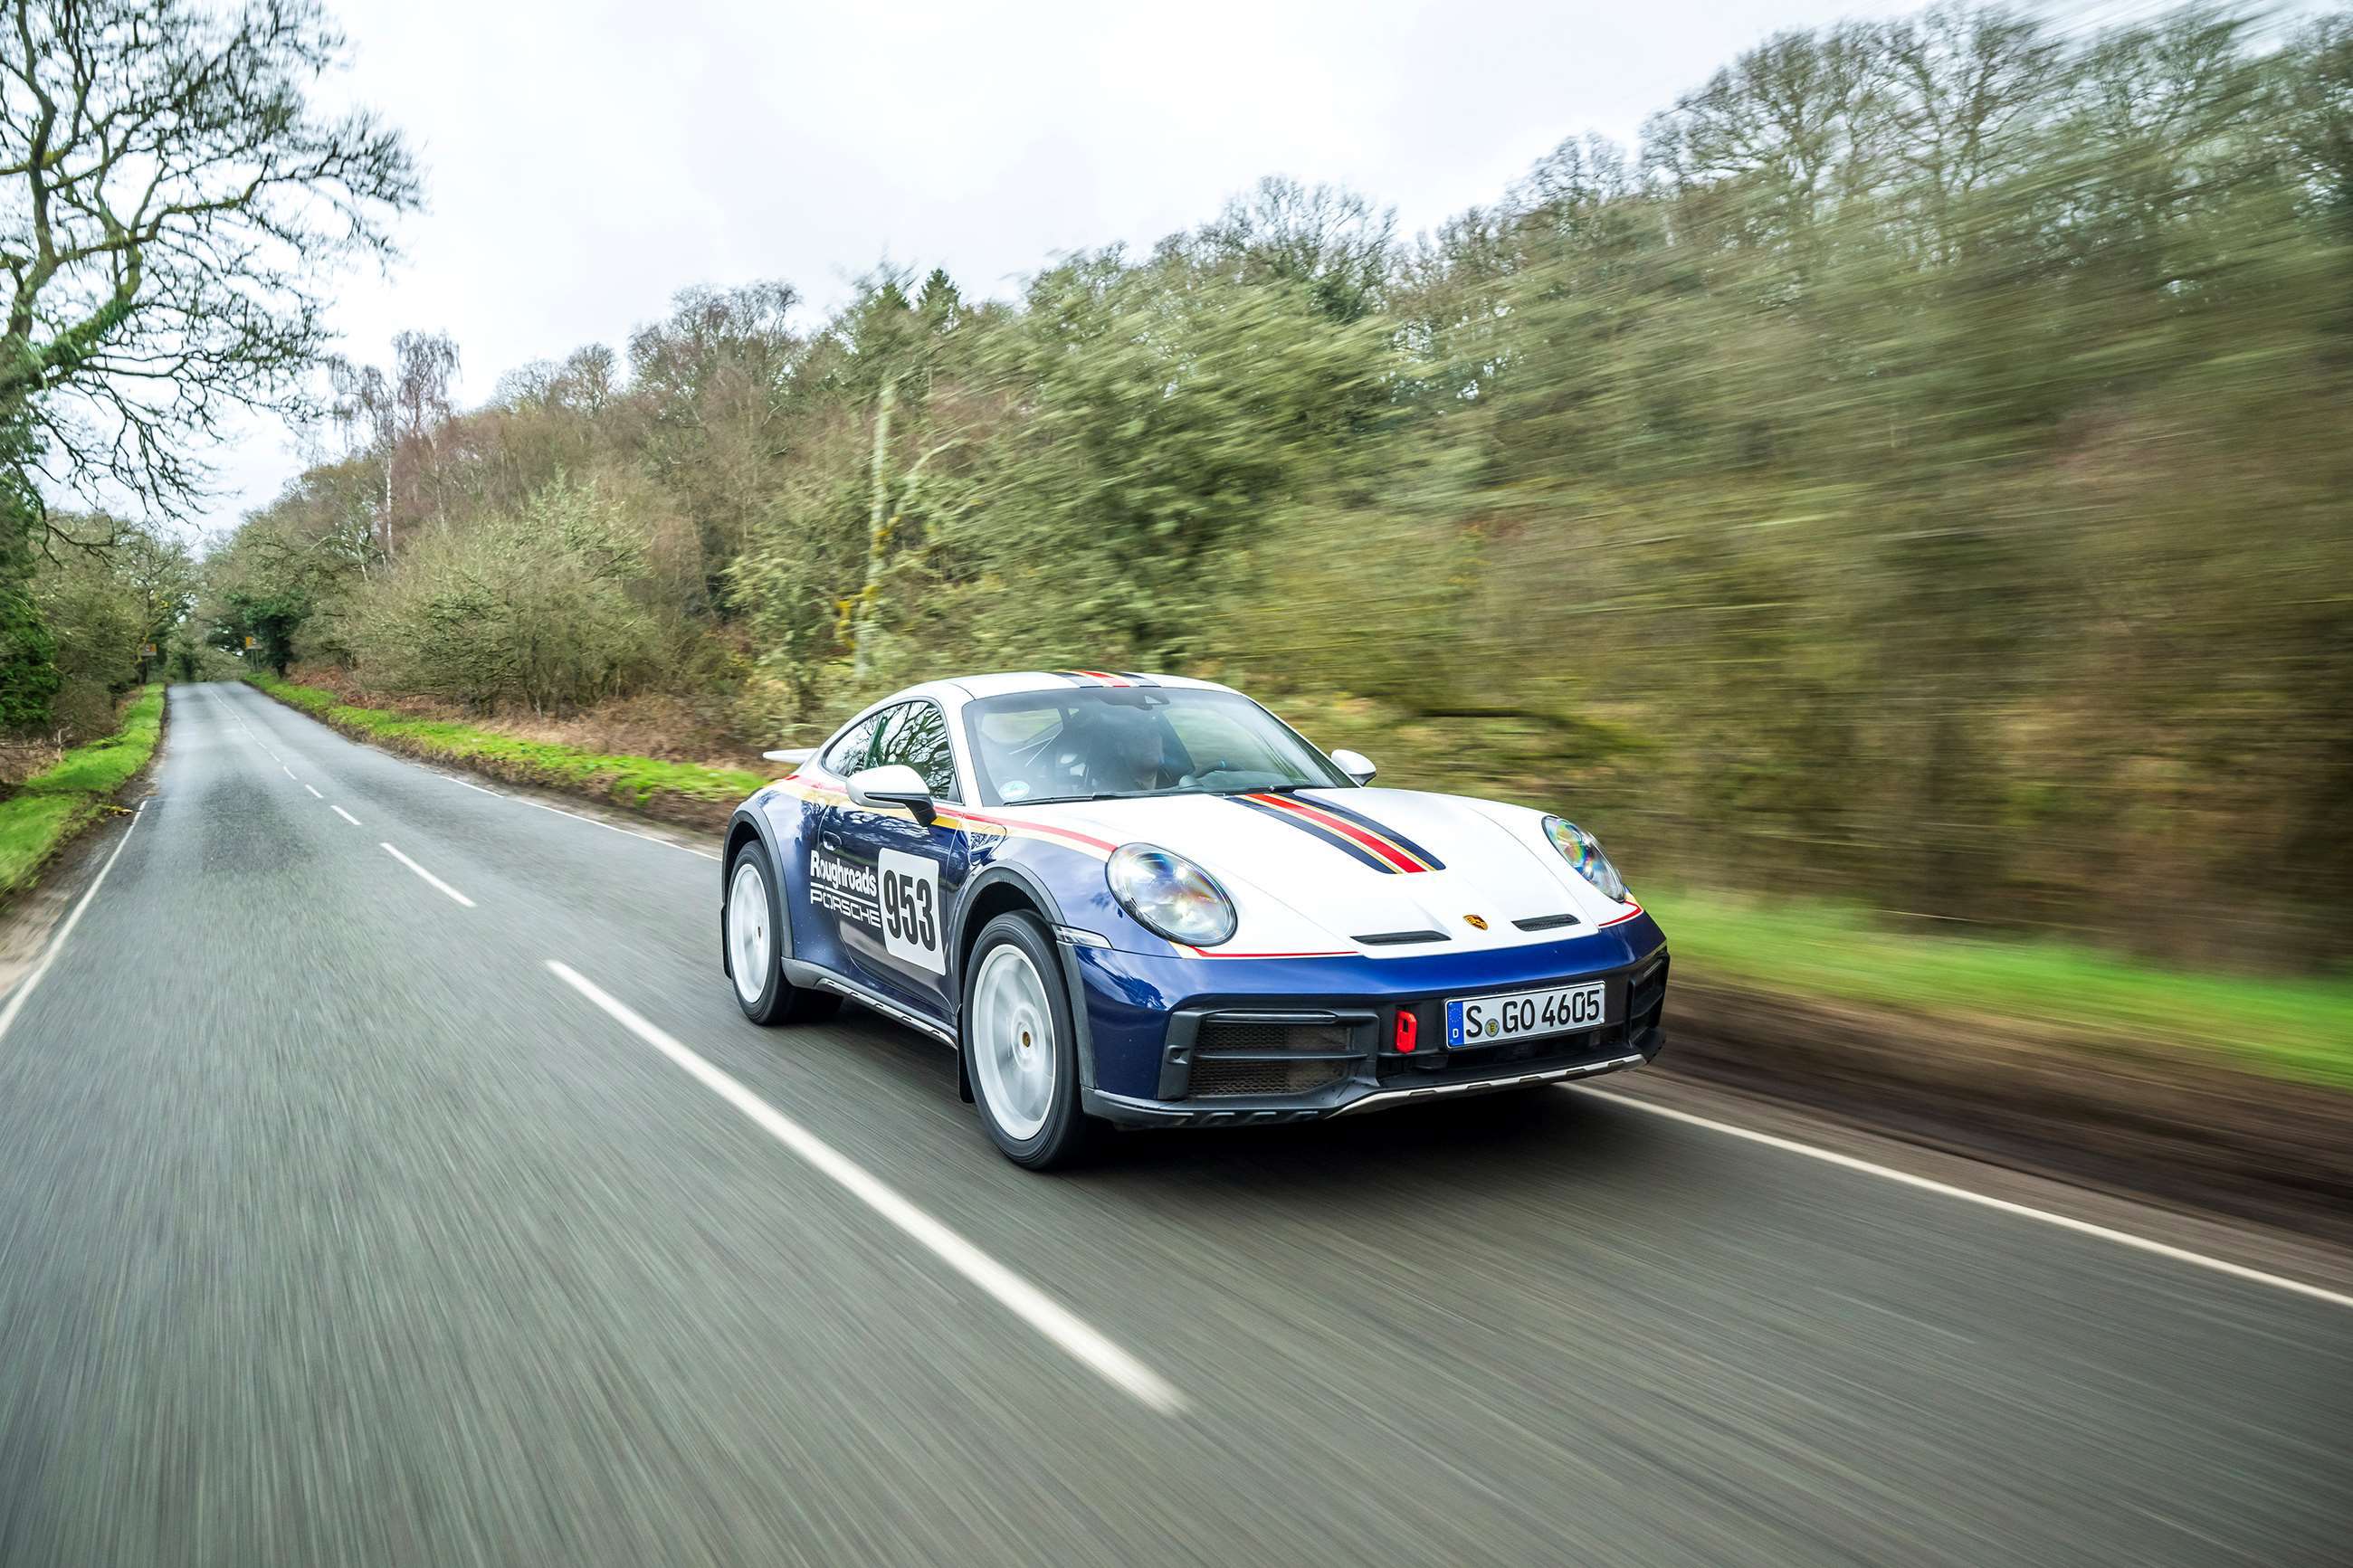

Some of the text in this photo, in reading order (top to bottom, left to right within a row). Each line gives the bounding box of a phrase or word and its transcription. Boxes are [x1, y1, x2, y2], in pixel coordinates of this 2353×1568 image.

[811, 850, 877, 898] Roughroads
[811, 889, 881, 928] PORSCHE
[883, 870, 937, 952] 953
[1453, 1028, 1459, 1038] D
[1465, 989, 1600, 1038] S GO 4605
